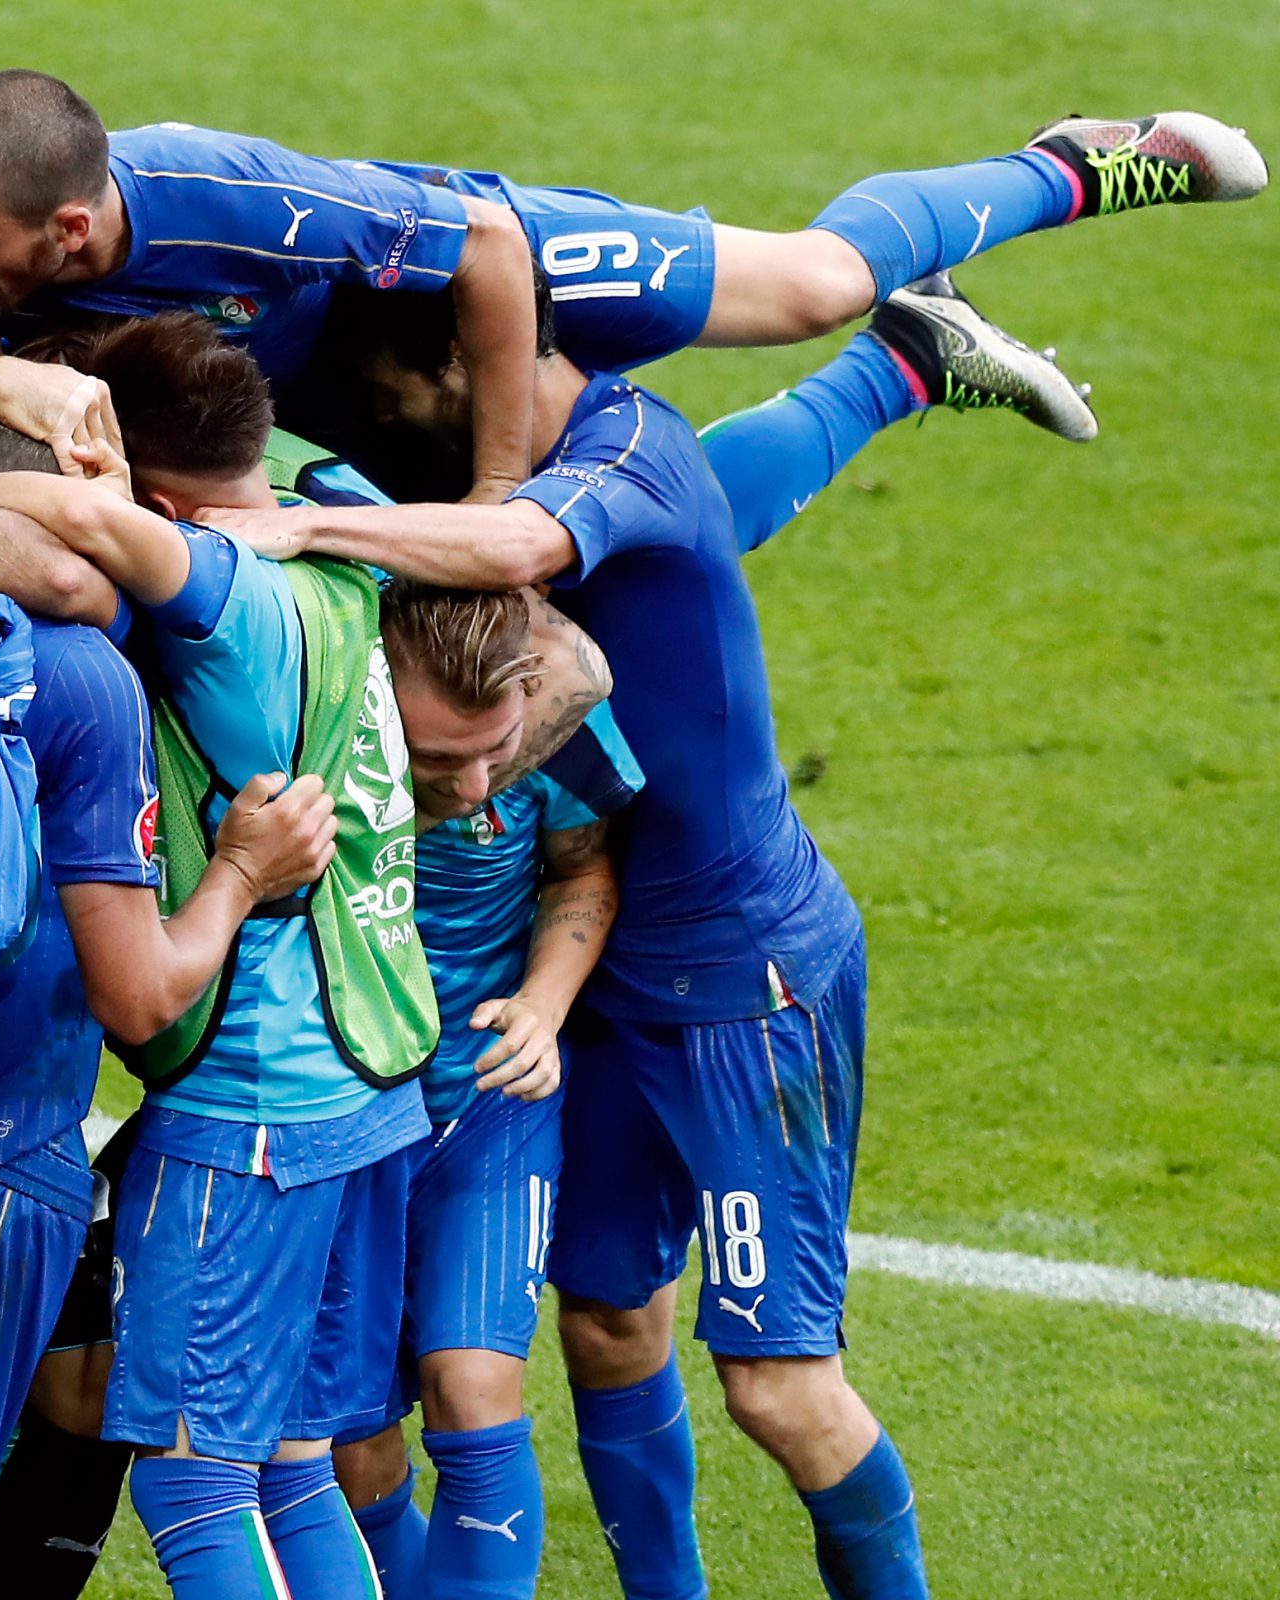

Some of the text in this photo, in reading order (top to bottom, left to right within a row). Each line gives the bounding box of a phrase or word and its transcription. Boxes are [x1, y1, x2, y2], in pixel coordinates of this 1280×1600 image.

[388, 207, 416, 267] RESPECT
[542, 231, 641, 302] 19
[702, 1189, 767, 1289] 18
